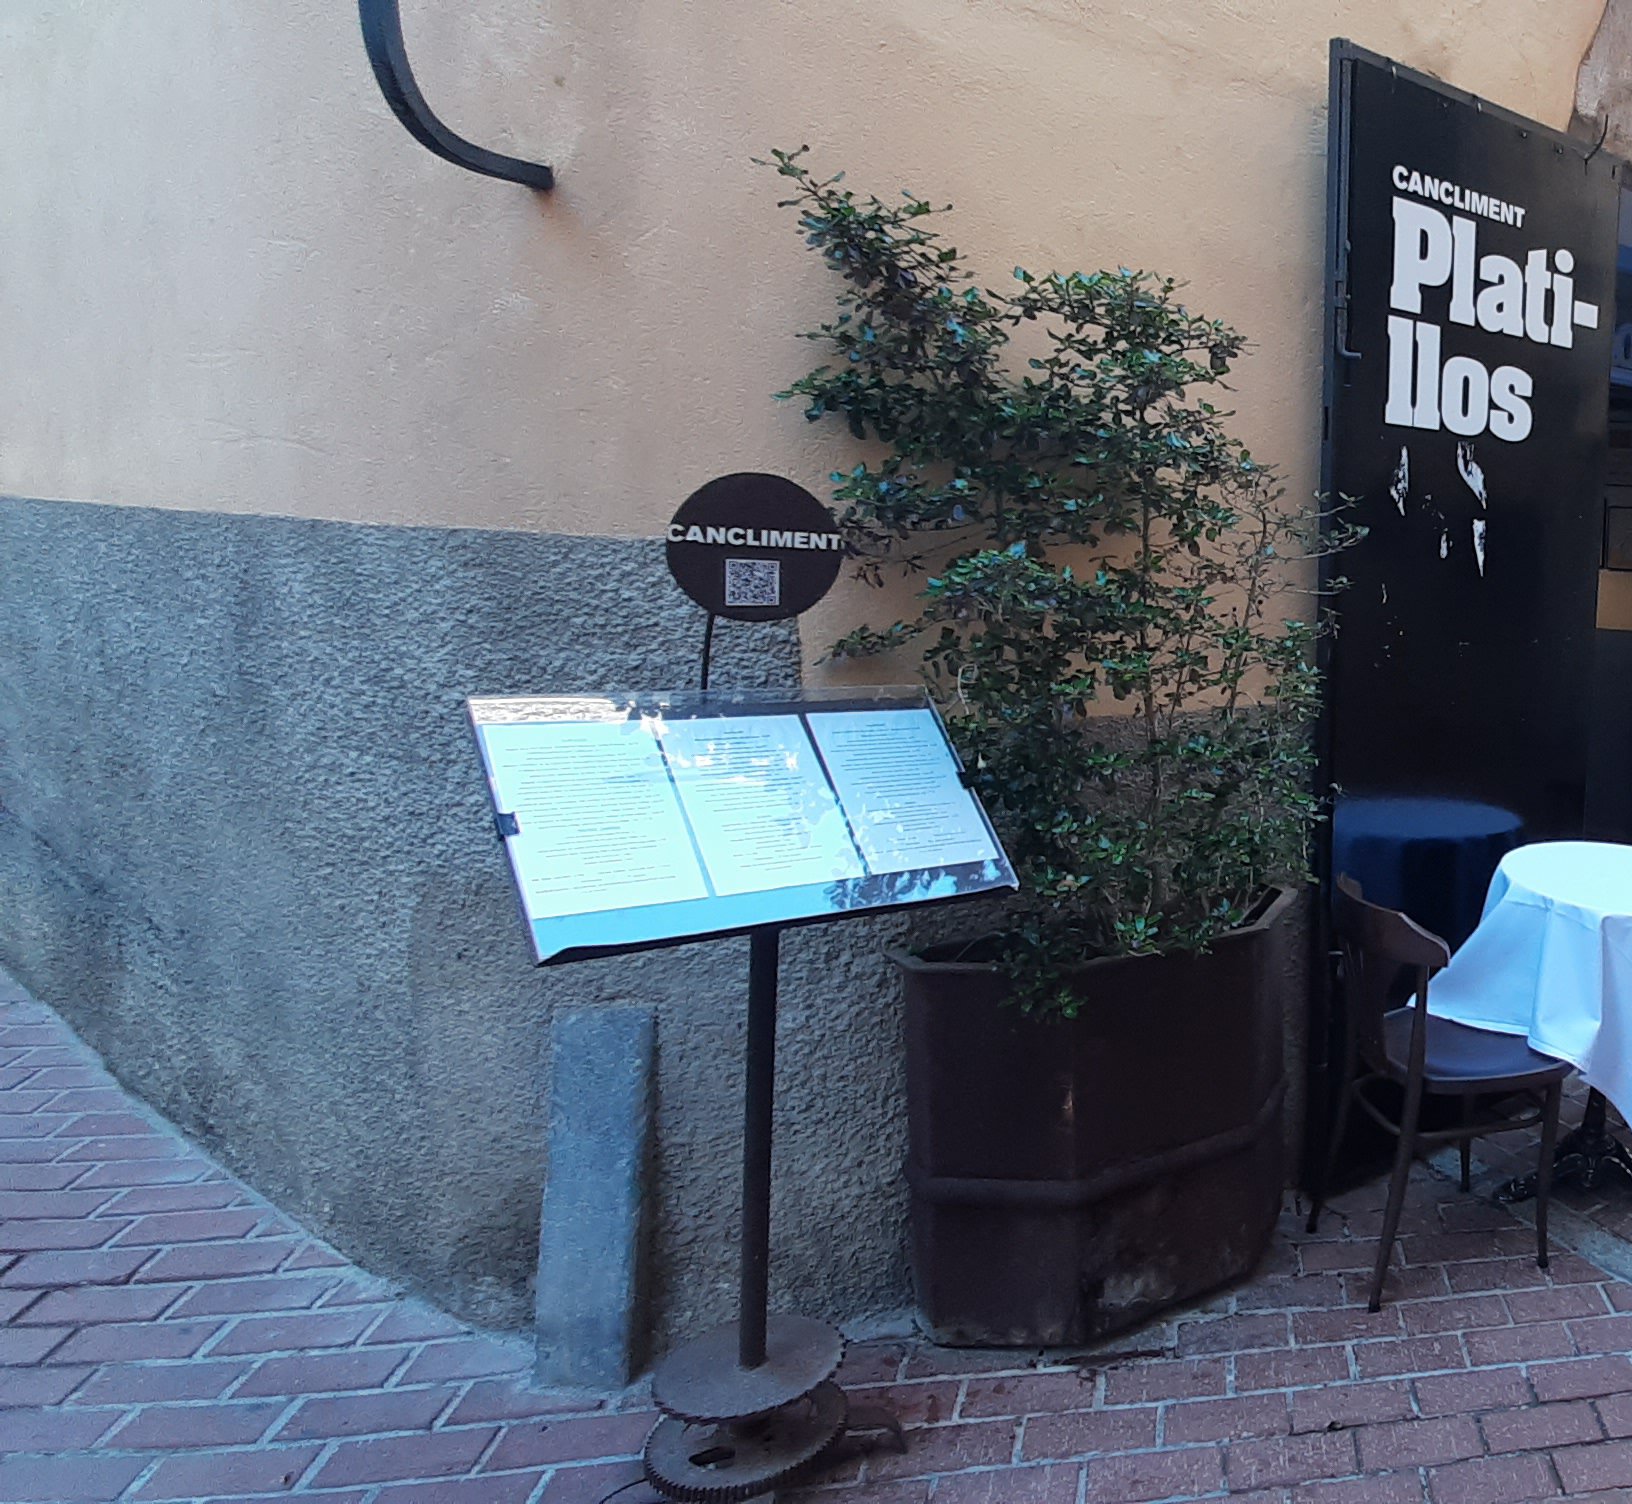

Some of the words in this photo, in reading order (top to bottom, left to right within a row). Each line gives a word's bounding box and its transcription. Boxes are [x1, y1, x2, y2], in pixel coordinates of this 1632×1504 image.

[1392, 165, 1526, 229] CANCLIMENT
[1389, 195, 1599, 350] Plati-
[1384, 314, 1534, 443] llos
[666, 523, 842, 551] CANCLIMENT
